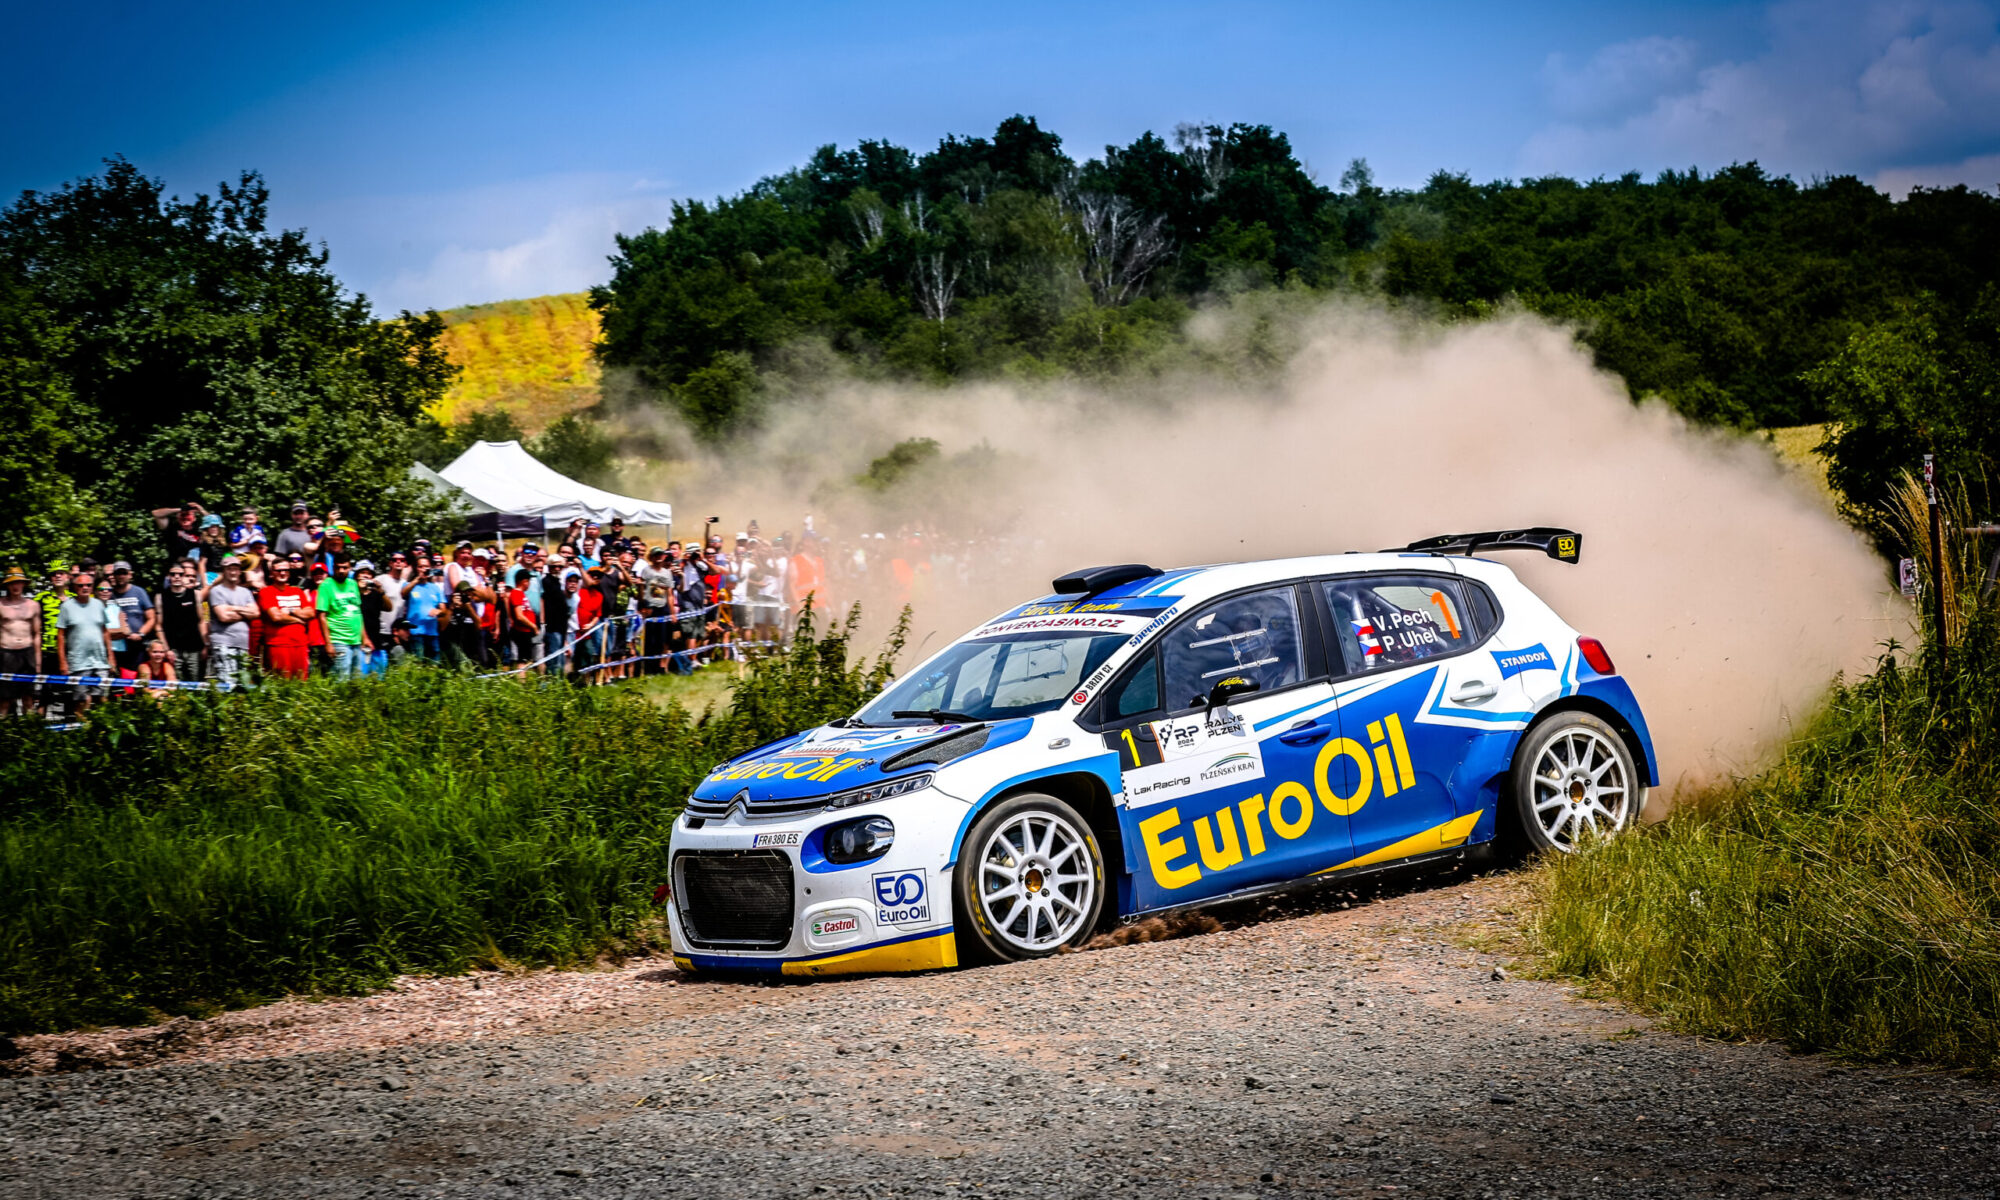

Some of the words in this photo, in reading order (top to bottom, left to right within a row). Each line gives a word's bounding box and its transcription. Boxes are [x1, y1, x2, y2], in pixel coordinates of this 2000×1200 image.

[1430, 591, 1461, 639] 1
[1129, 606, 1179, 648] speedpro
[1500, 652, 1548, 668] STANDOX
[1085, 671, 1105, 691] BRZDY
[1174, 725, 1200, 740] RP
[1120, 728, 1142, 768] 1
[710, 757, 867, 783] EuroOil
[1237, 761, 1255, 772] KRAJ
[1133, 785, 1152, 796] Lak
[1153, 776, 1191, 791] Racing
[1138, 712, 1417, 890] EuroOil
[757, 835, 768, 846] FR
[772, 834, 787, 845] 380
[787, 833, 799, 844] ES
[823, 918, 856, 933] Castrol
